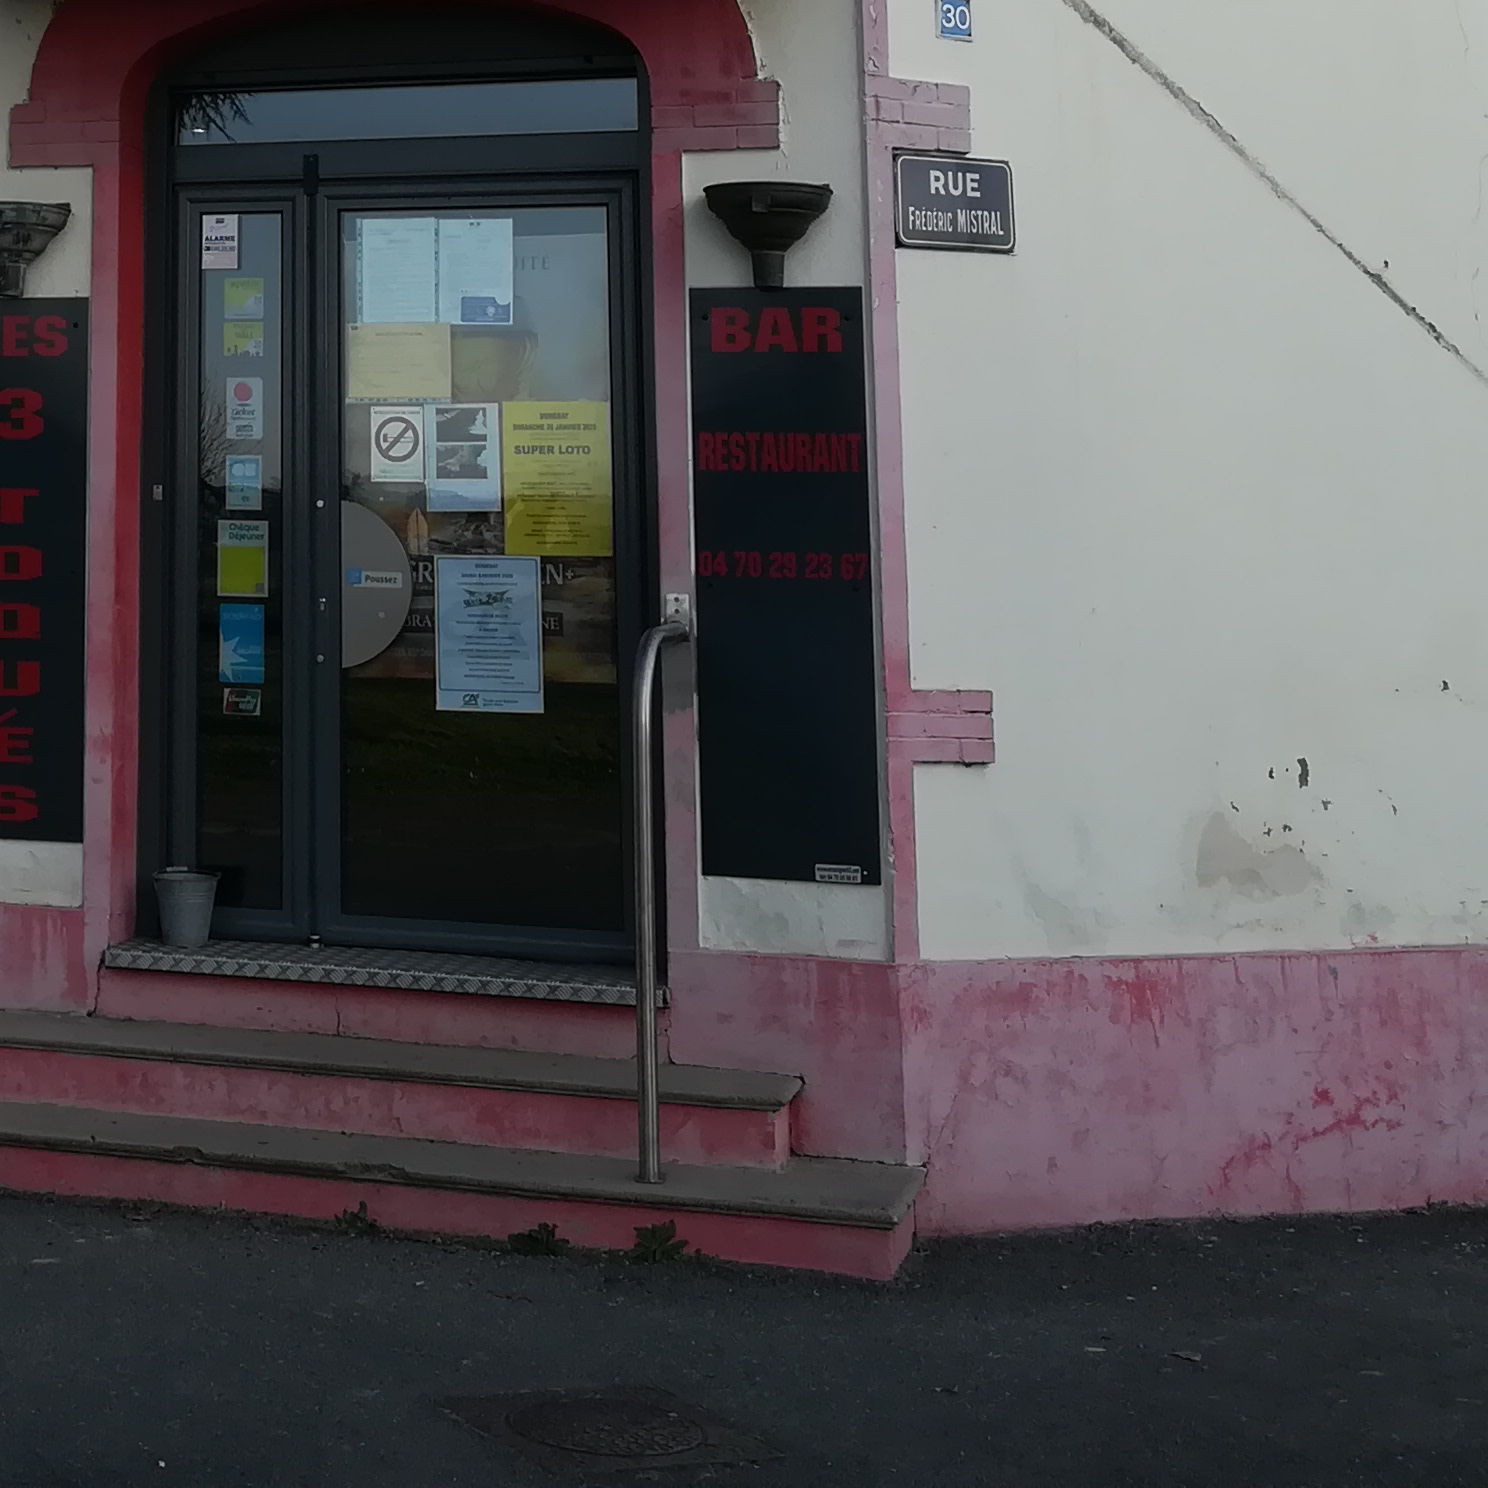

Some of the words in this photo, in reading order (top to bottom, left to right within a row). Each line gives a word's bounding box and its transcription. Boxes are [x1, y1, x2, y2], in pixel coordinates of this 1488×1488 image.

[941, 3, 970, 30] 30
[928, 169, 981, 198] RUE
[711, 306, 844, 353] BAR
[513, 444, 555, 455] SUPER
[558, 444, 592, 455] LOTO
[699, 432, 863, 473] RESTAURANT
[365, 574, 398, 584] Poussez
[699, 551, 728, 577] 04
[734, 551, 762, 578] 70
[769, 552, 797, 579] 29
[805, 552, 833, 579] 23
[840, 553, 868, 581] 67
